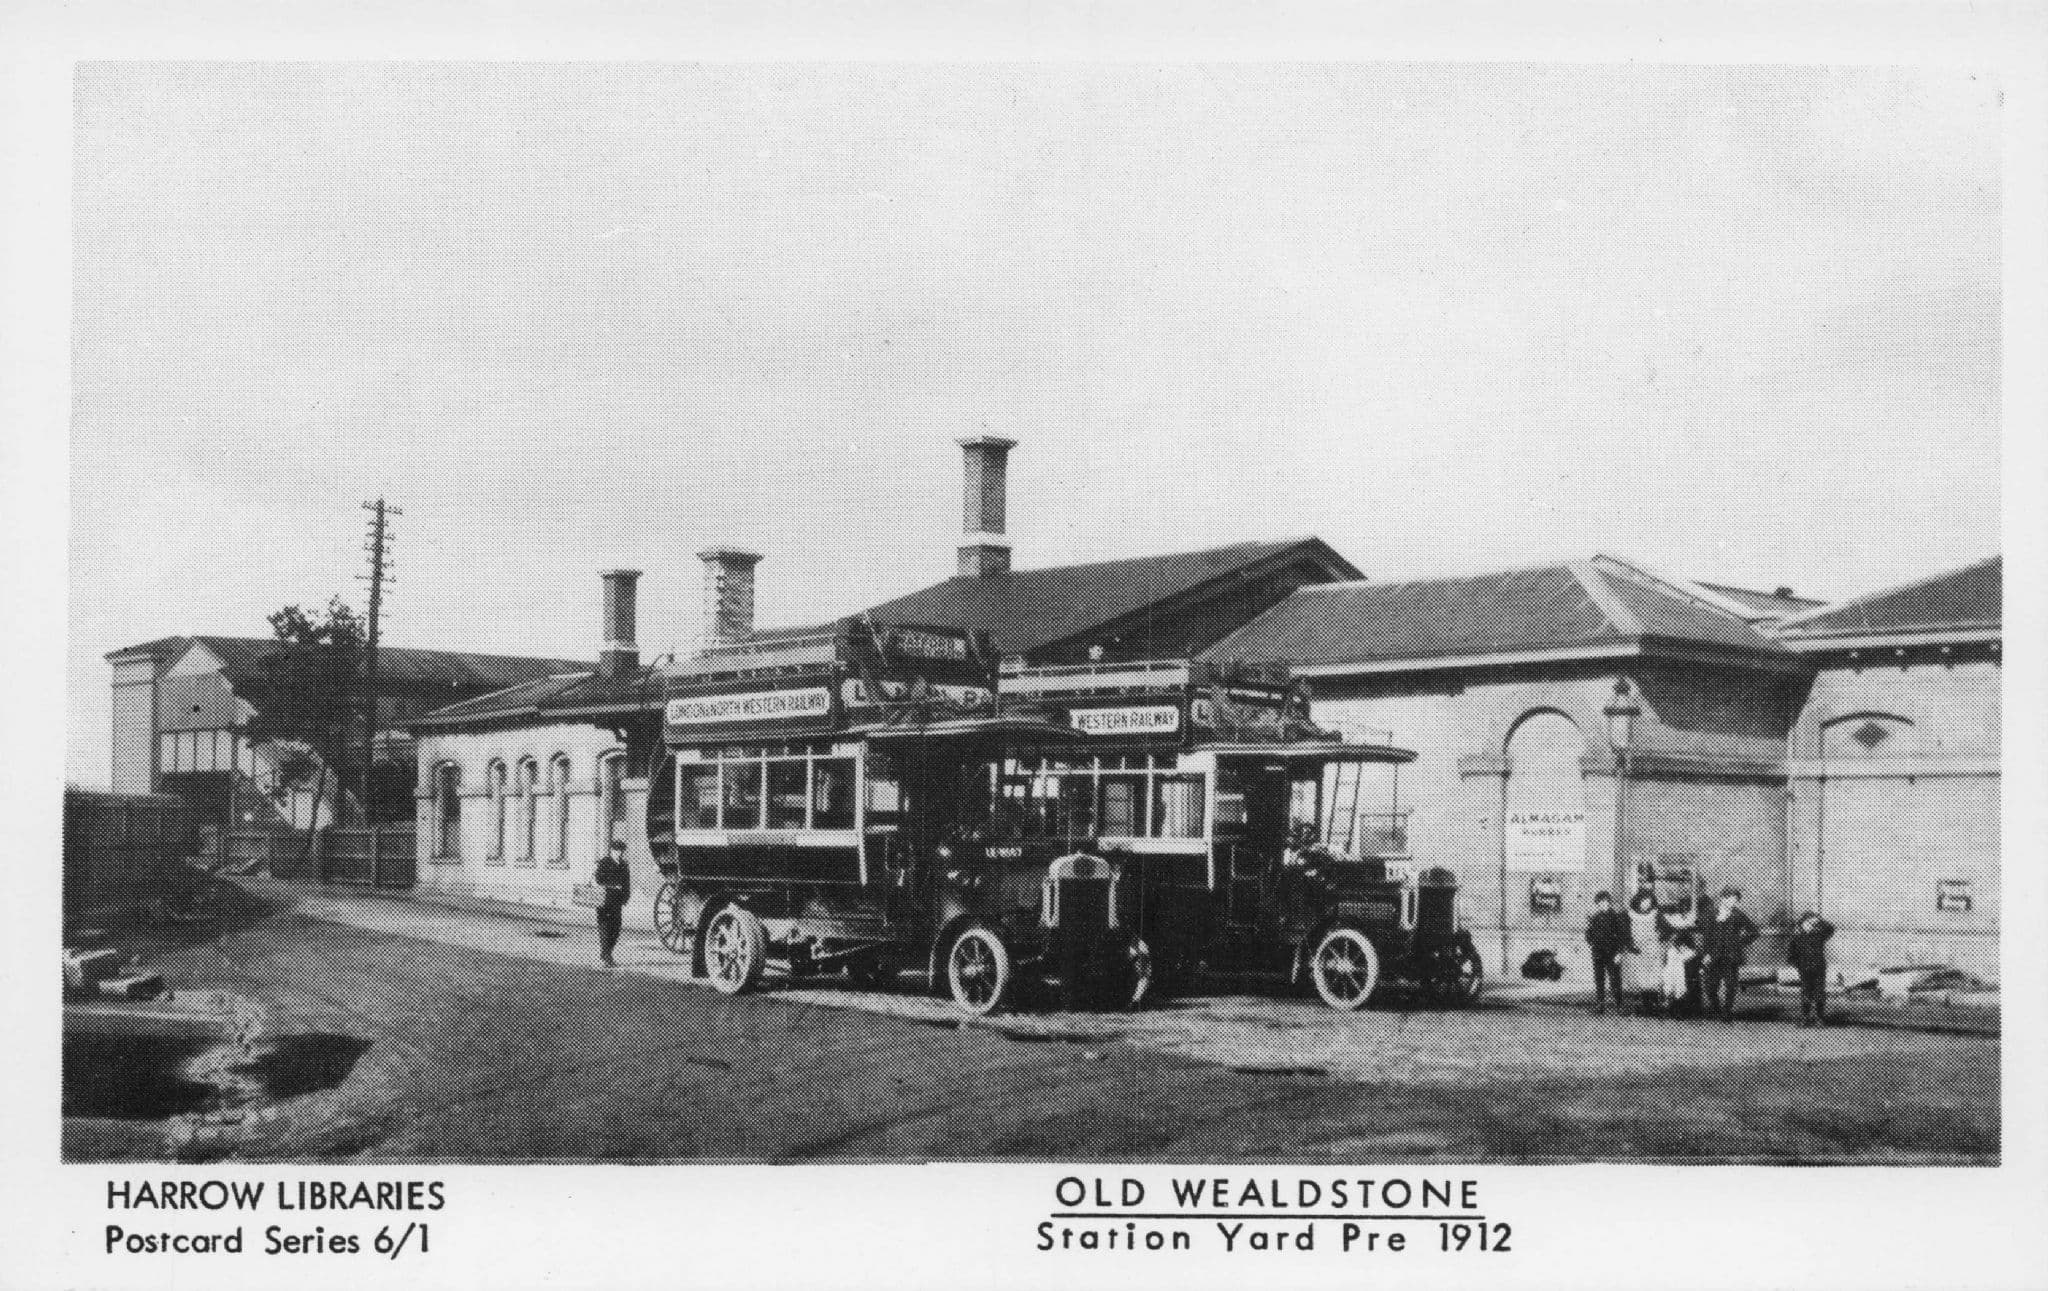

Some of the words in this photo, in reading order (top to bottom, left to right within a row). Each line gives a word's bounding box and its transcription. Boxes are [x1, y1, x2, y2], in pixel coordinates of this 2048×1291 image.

[743, 696, 786, 715] WESTERN
[788, 692, 826, 712] RAILWAY
[1077, 712, 1128, 730] WESTERN
[1130, 710, 1175, 728] RAILWAY
